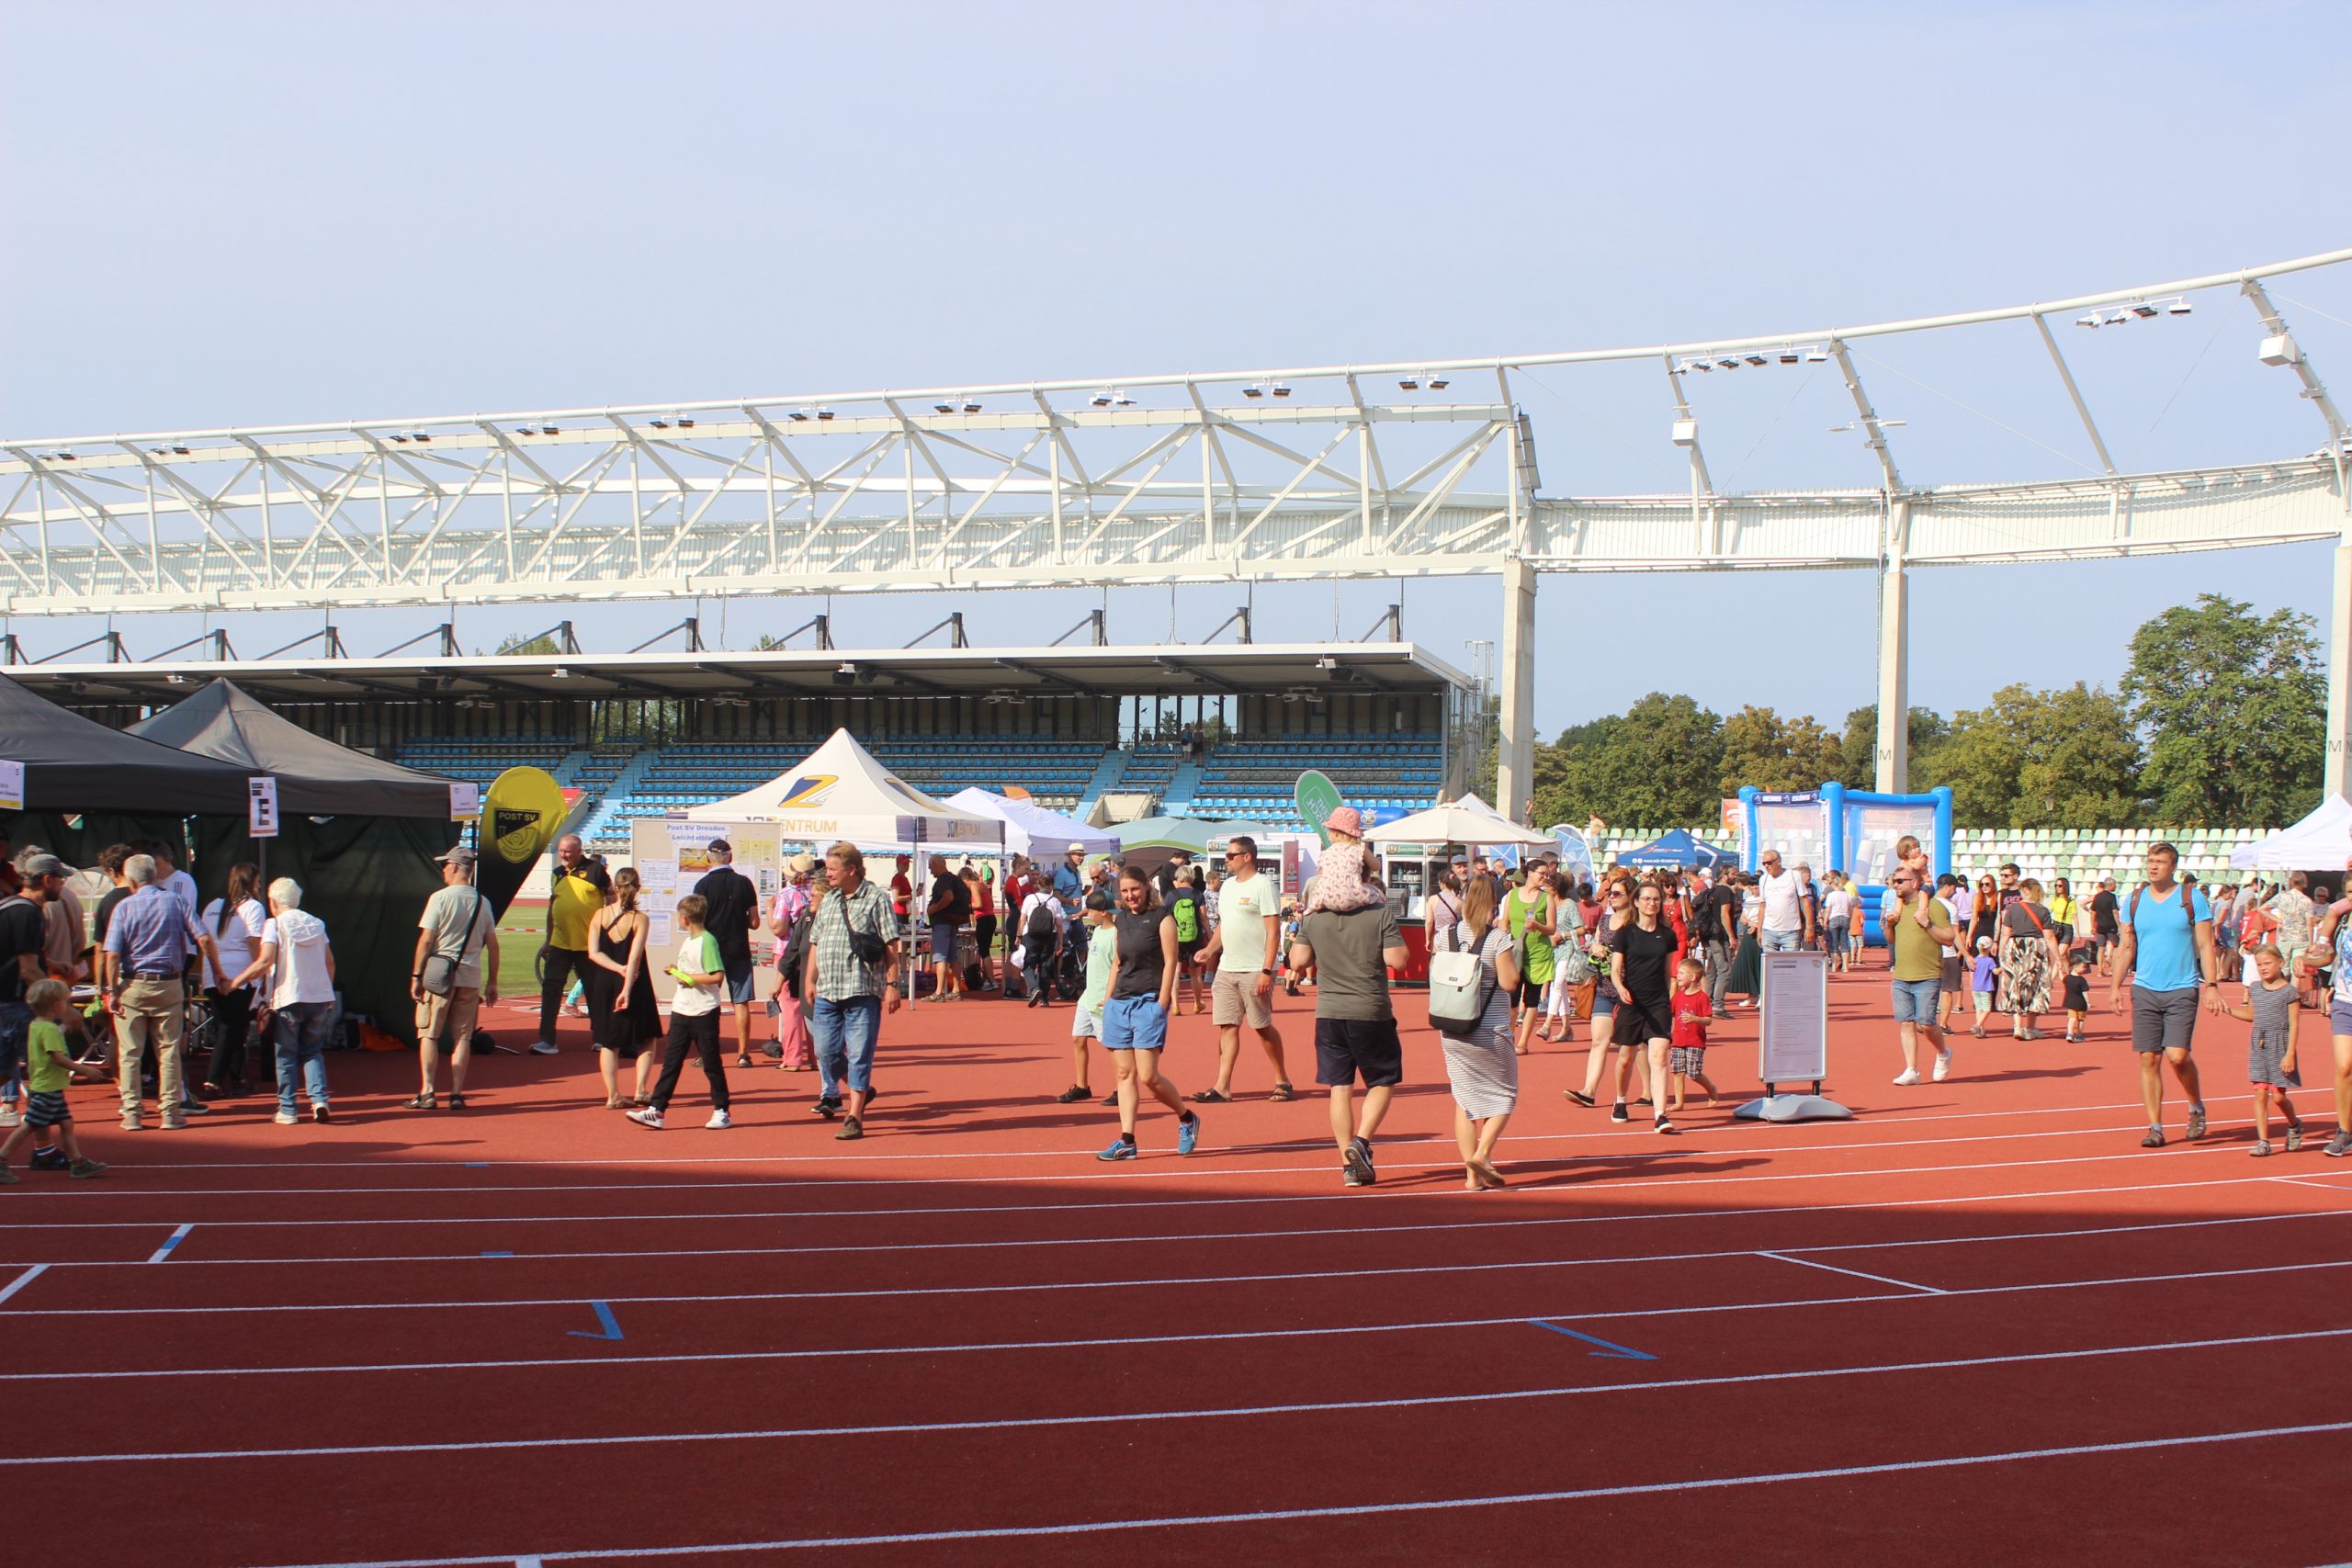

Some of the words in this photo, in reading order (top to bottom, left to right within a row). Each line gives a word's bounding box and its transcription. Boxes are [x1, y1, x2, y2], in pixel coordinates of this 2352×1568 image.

[2328, 740, 2342, 752] M
[1879, 750, 1891, 761] M
[258, 798, 269, 826] E
[499, 812, 523, 820] POST
